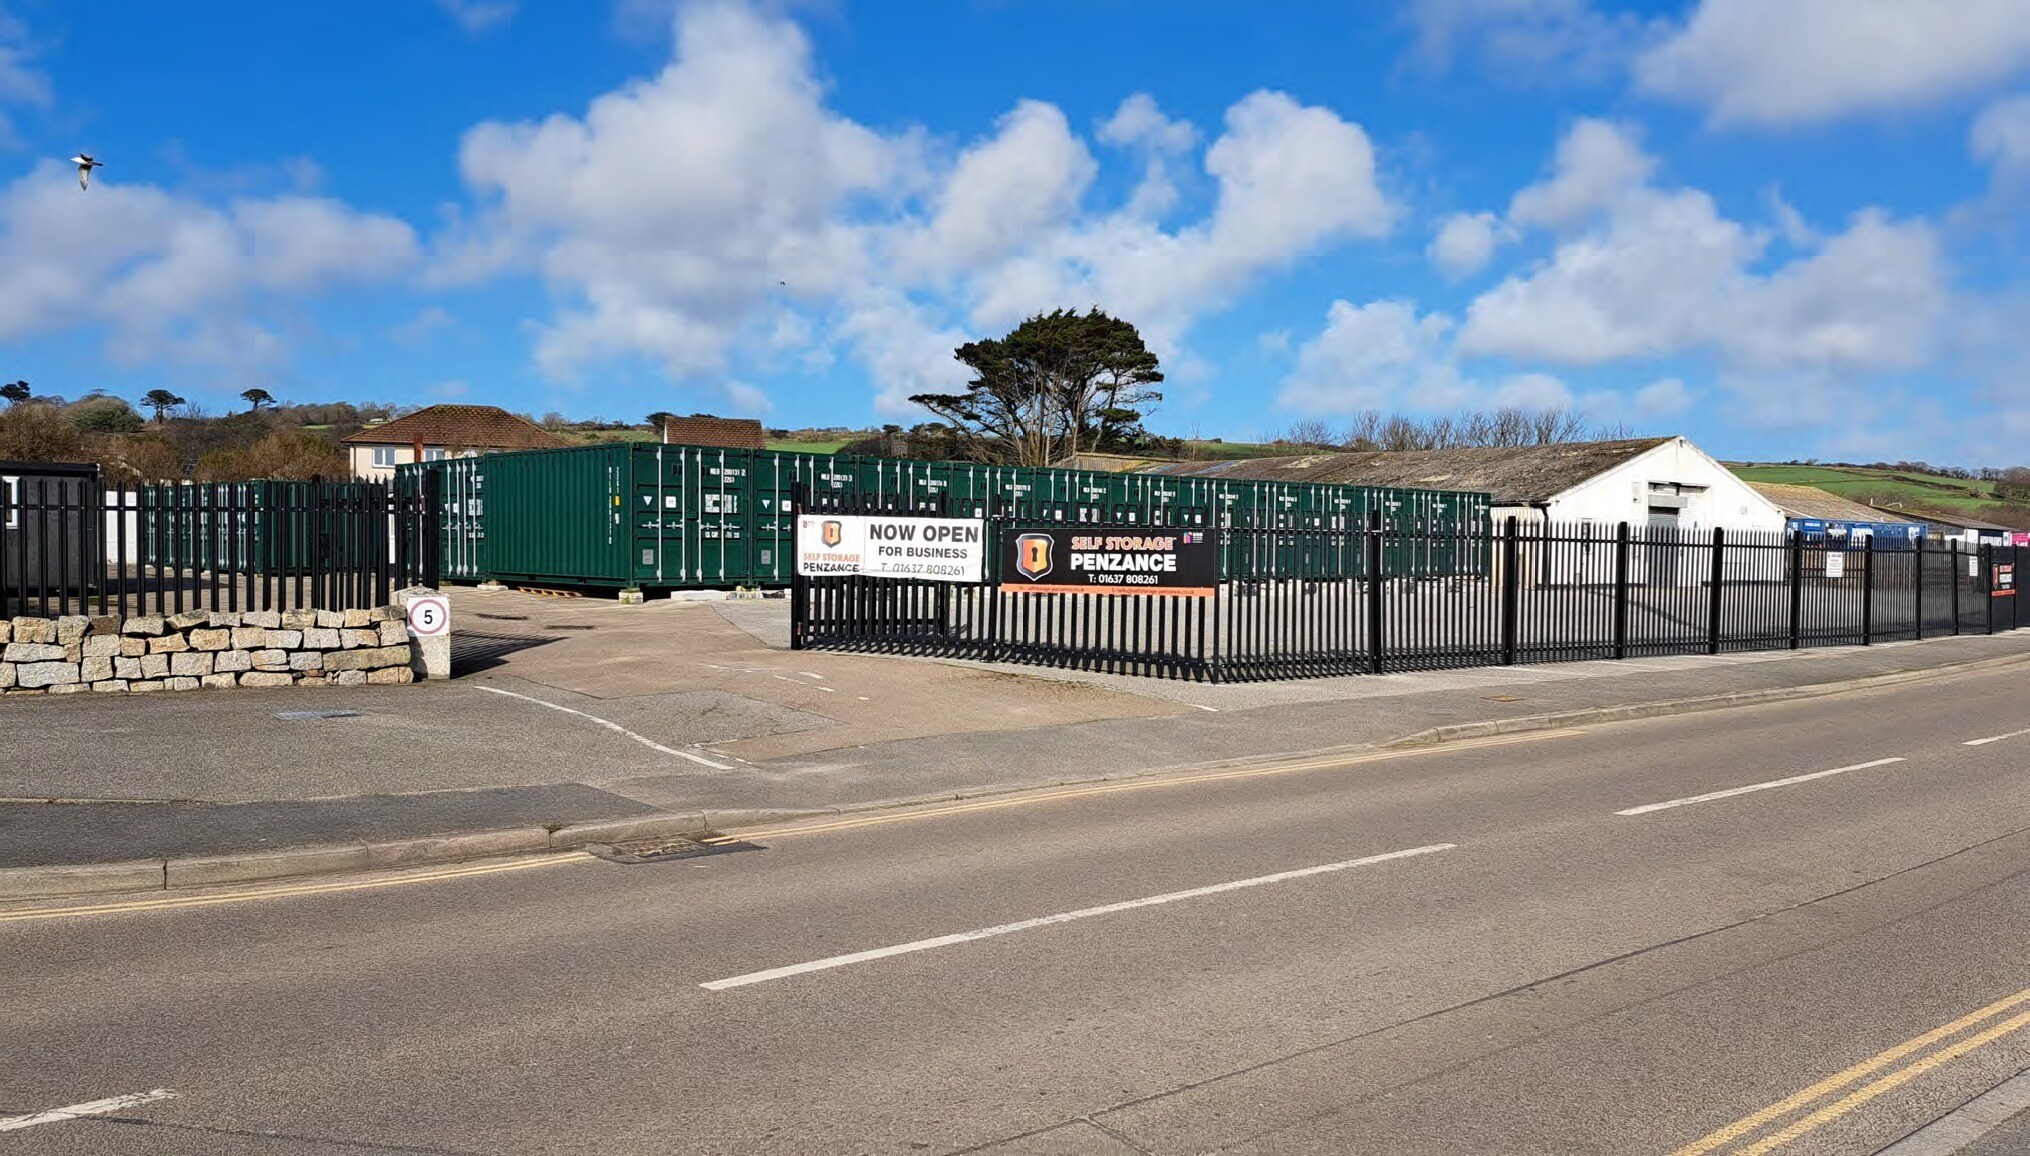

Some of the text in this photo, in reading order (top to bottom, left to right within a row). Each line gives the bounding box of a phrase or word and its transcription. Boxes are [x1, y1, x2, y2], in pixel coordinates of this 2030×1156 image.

[869, 523, 979, 543] NOW OPEN
[1071, 536, 1103, 550] SELF
[1105, 536, 1175, 551] STORAGE
[803, 552, 861, 563] SELF STORAGE
[878, 546, 968, 559] FOR BUSINESS
[803, 562, 860, 573] PENZANCE
[892, 563, 923, 574] 01637
[926, 564, 965, 576] 808261
[1070, 554, 1177, 572] PENZANCE
[1088, 573, 1159, 585] T: 01637 808261
[424, 609, 433, 625] 5
